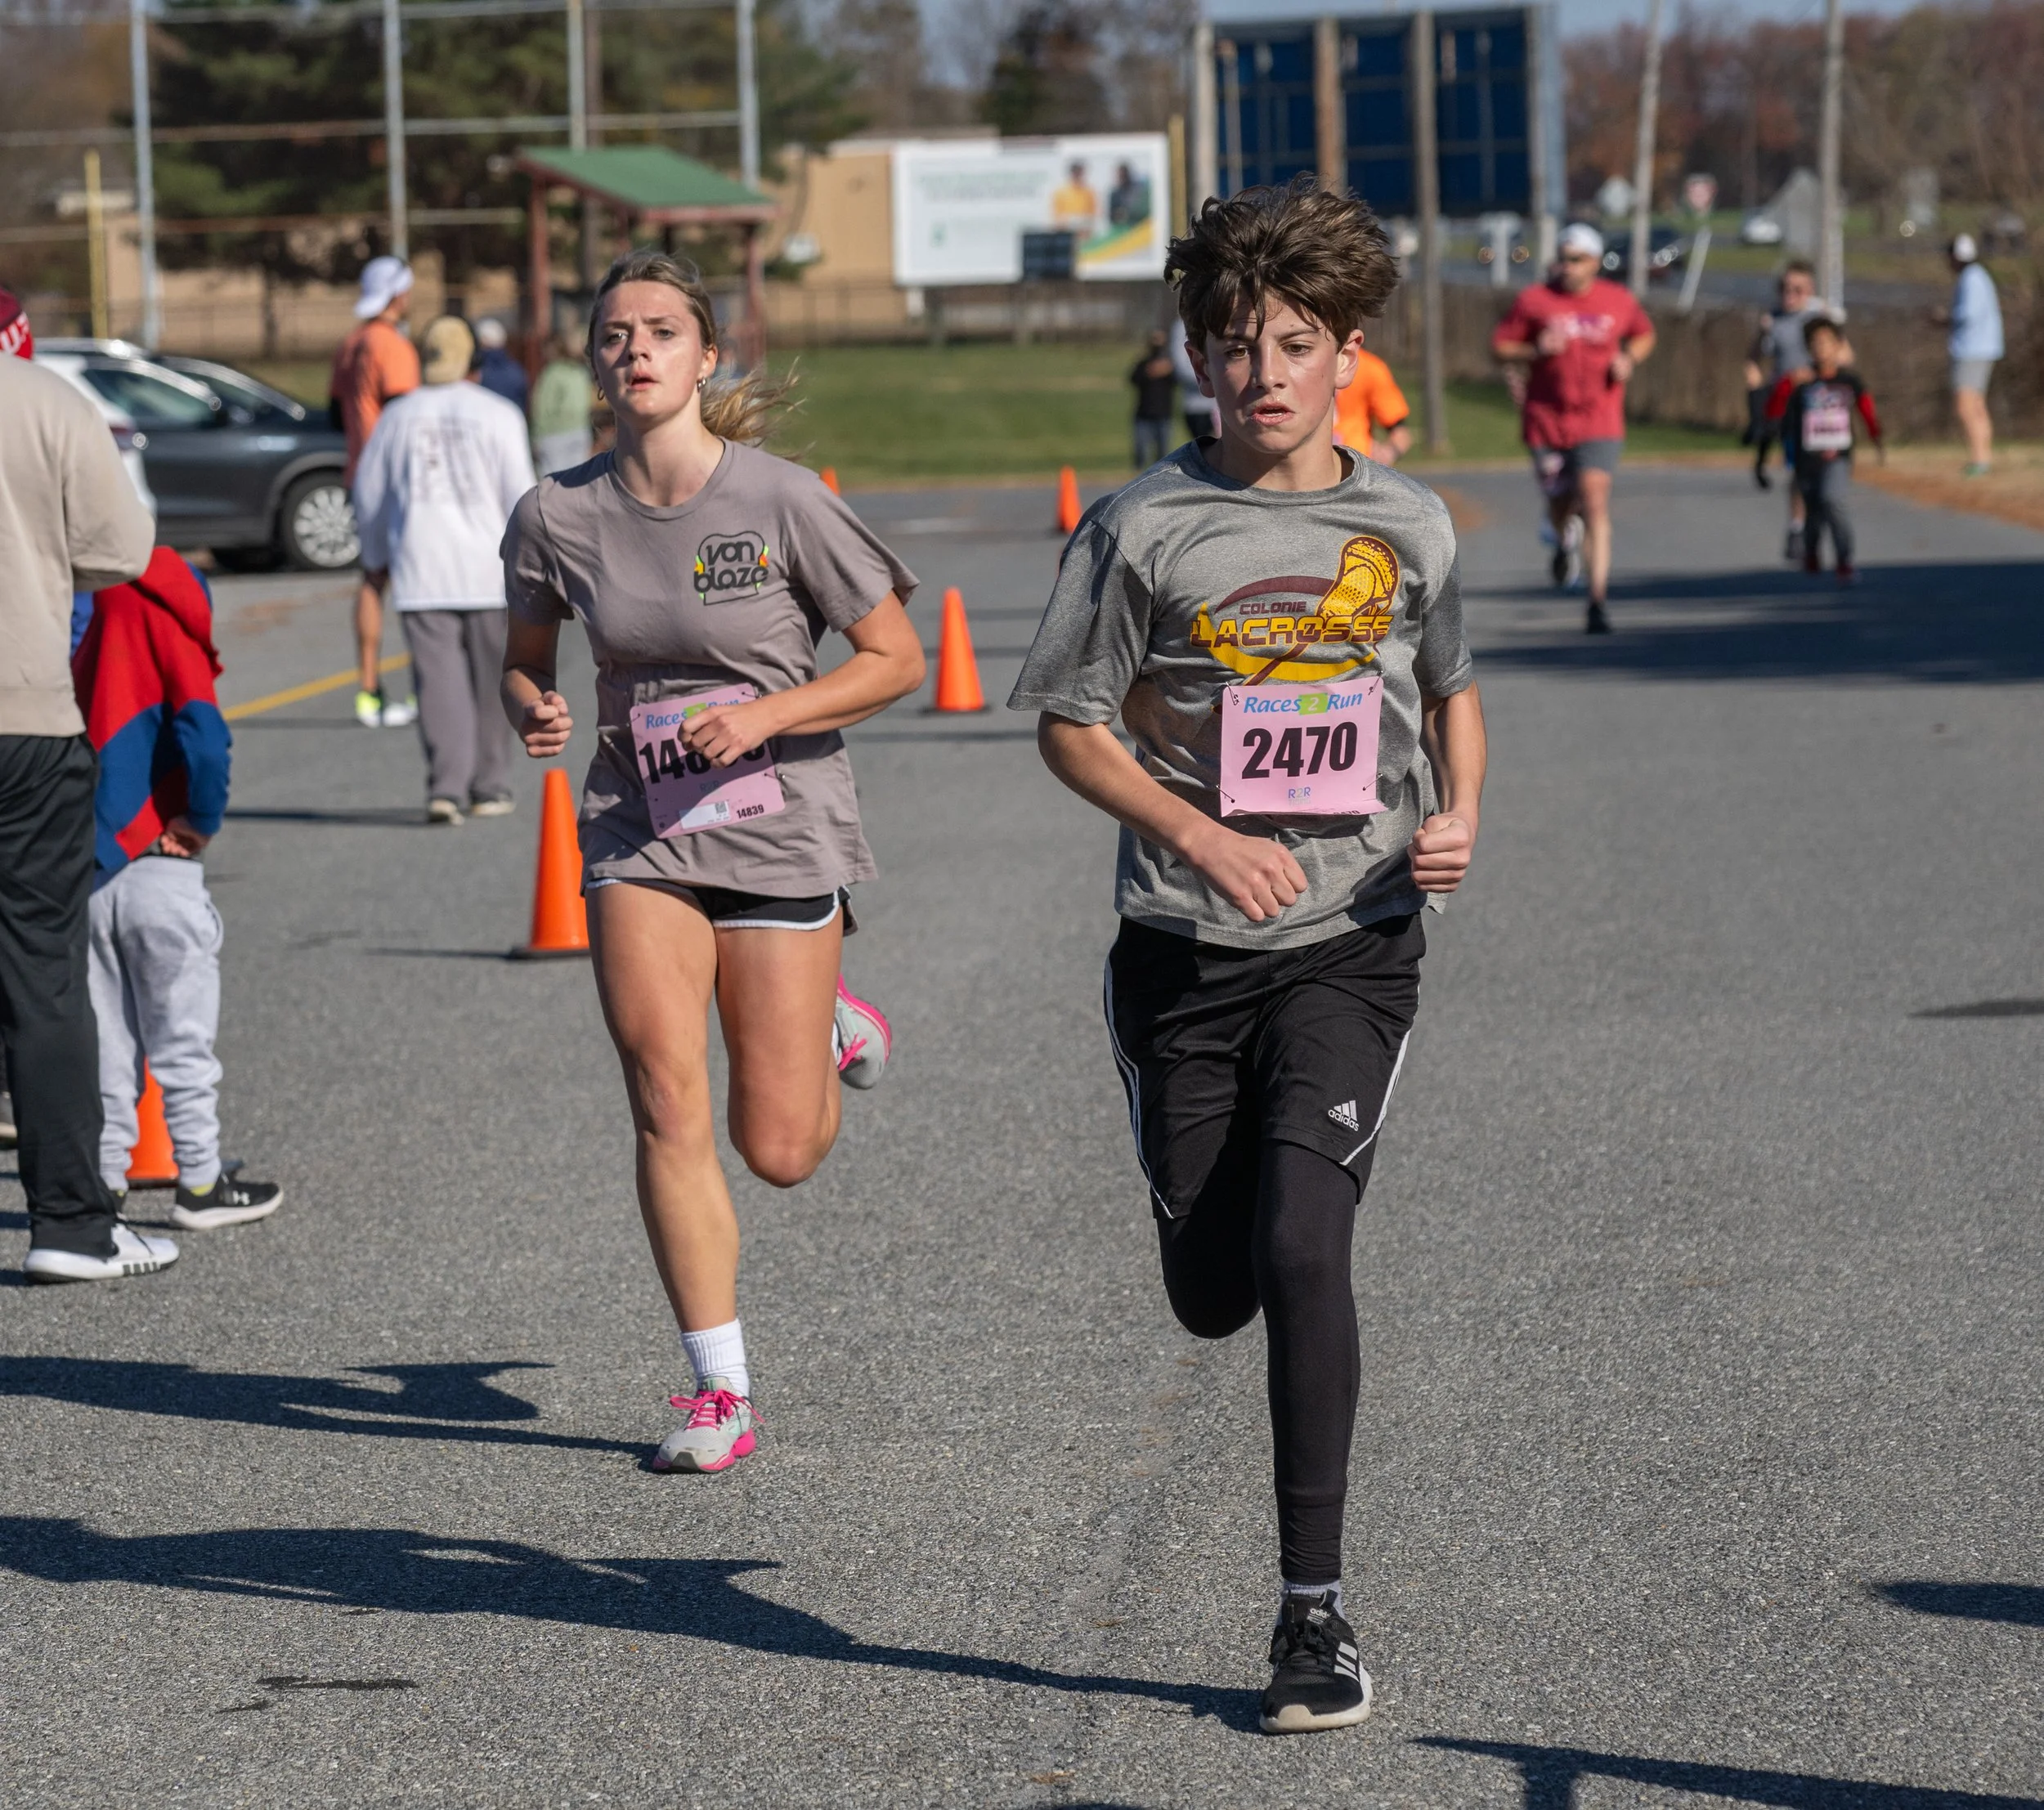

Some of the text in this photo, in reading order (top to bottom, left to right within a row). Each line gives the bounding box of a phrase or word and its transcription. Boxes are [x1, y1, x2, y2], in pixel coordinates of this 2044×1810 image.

[694, 566, 769, 593] blaze
[1239, 601, 1307, 615] COLONIE
[1190, 615, 1393, 648] LACROSSE
[1244, 696, 1302, 713] Races
[1327, 693, 1363, 710] Run
[1242, 722, 1358, 779] 2470
[1288, 786, 1311, 799] R2R
[737, 804, 764, 818] 14839
[1328, 1109, 1359, 1131] adidas
